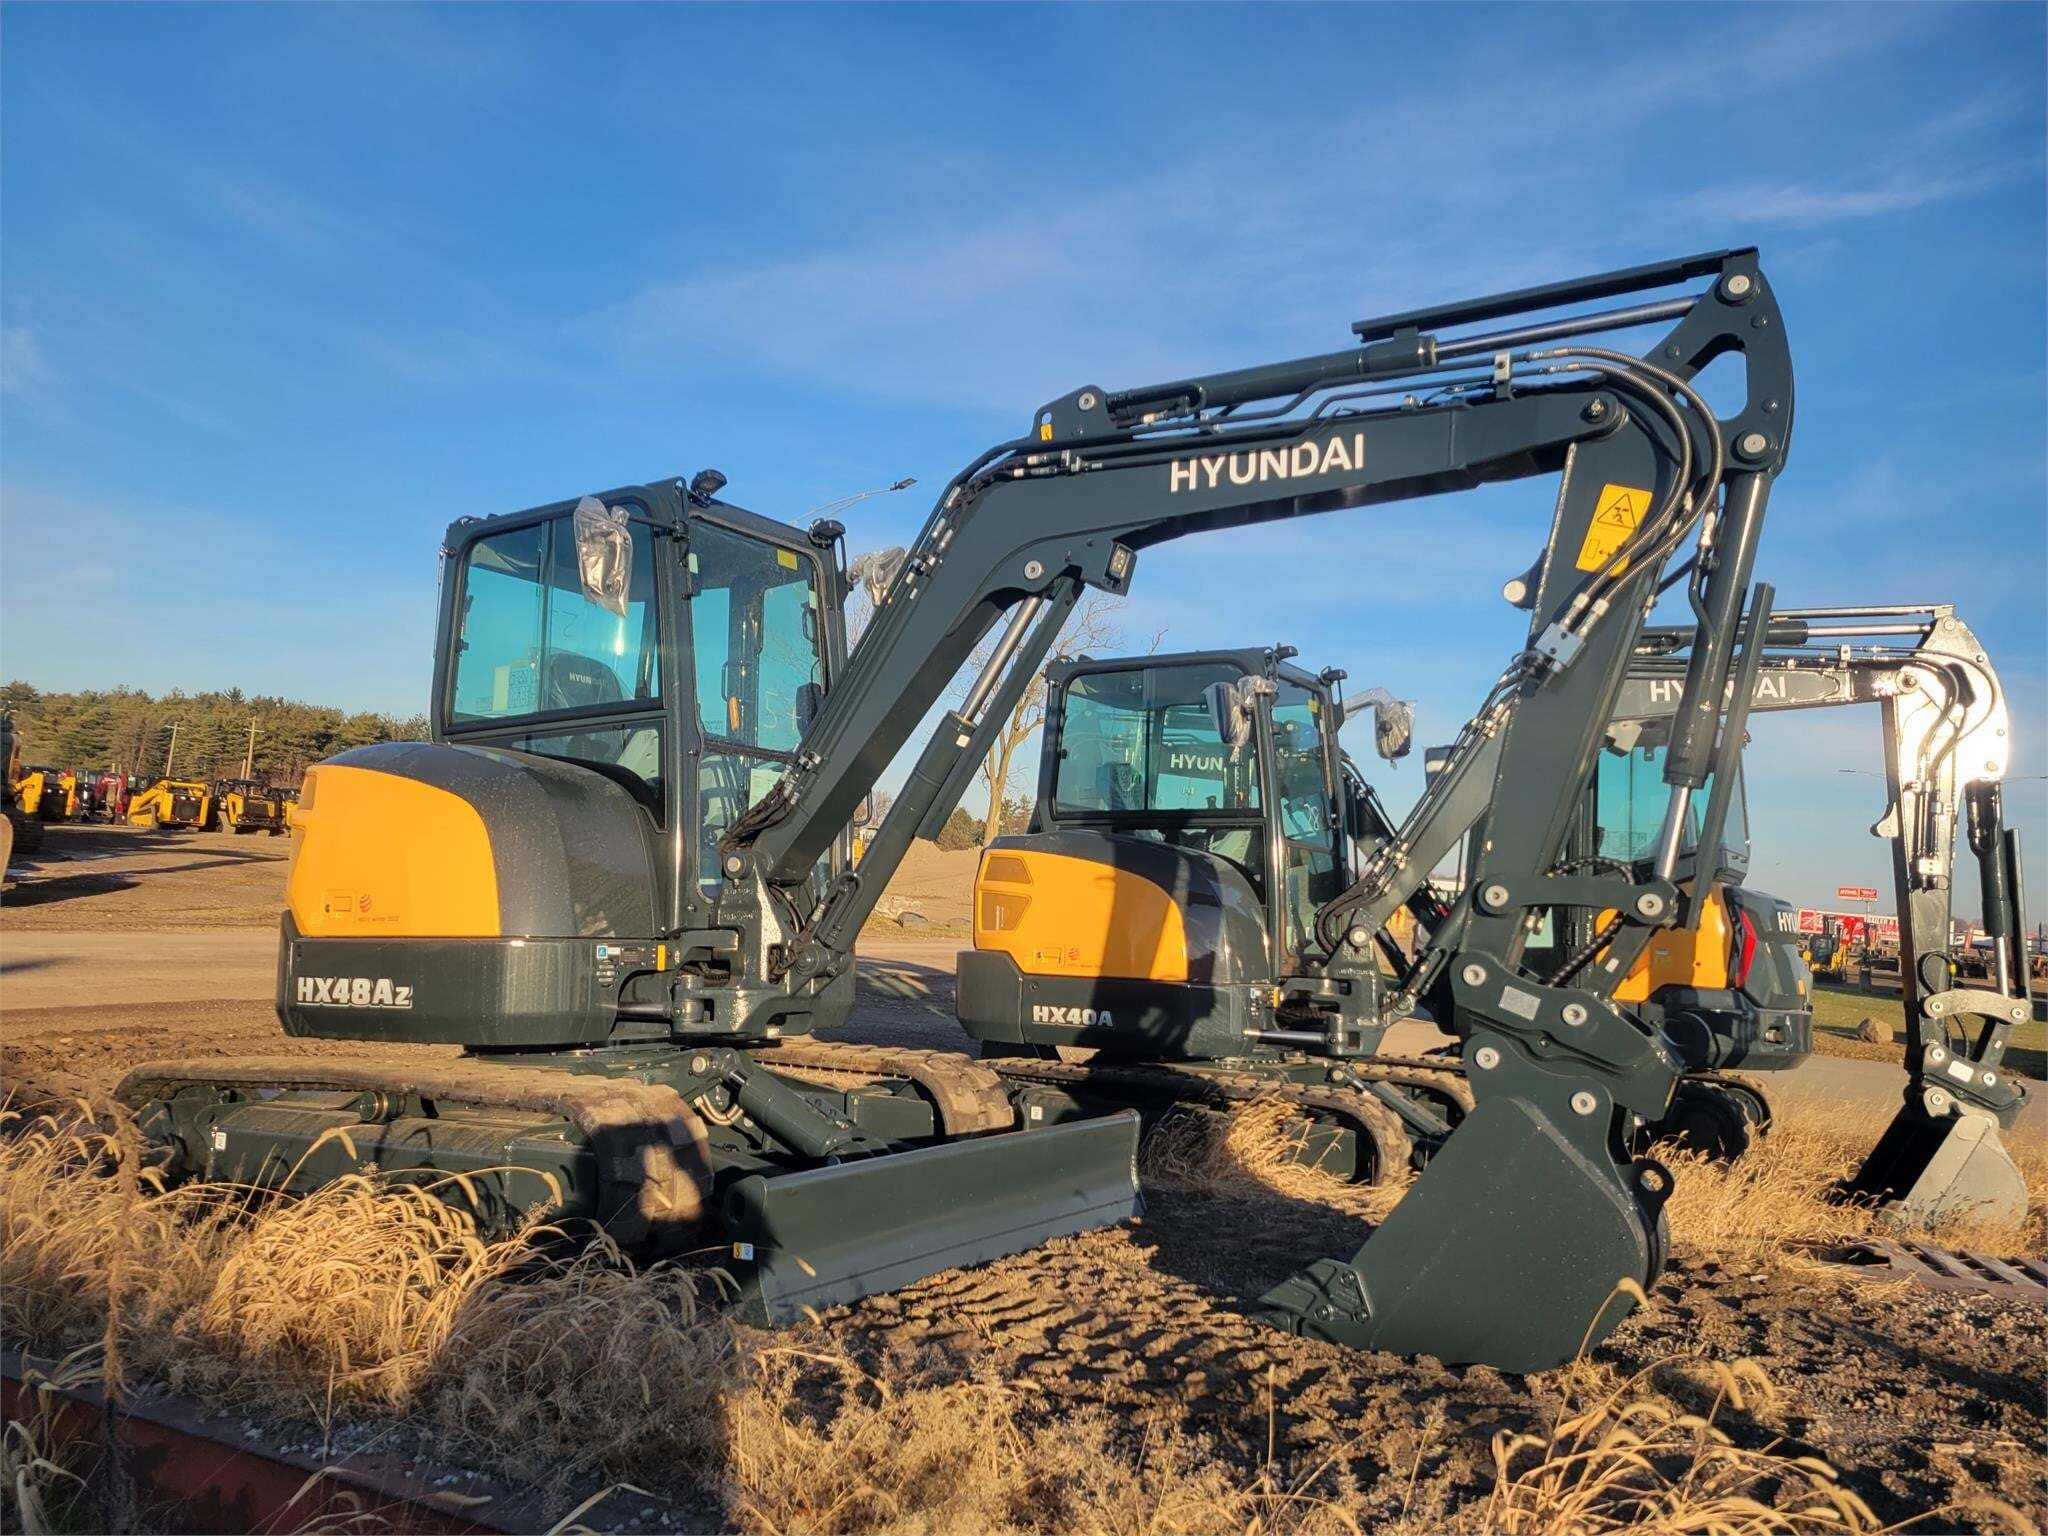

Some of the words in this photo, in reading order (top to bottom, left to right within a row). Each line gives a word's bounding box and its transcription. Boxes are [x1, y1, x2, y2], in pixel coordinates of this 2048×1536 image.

[1170, 433, 1365, 492] HYUNDAI
[1650, 676, 1787, 702] HYNAI
[1170, 753, 1223, 771] HYUN
[1032, 1004, 1114, 1028] HX40A
